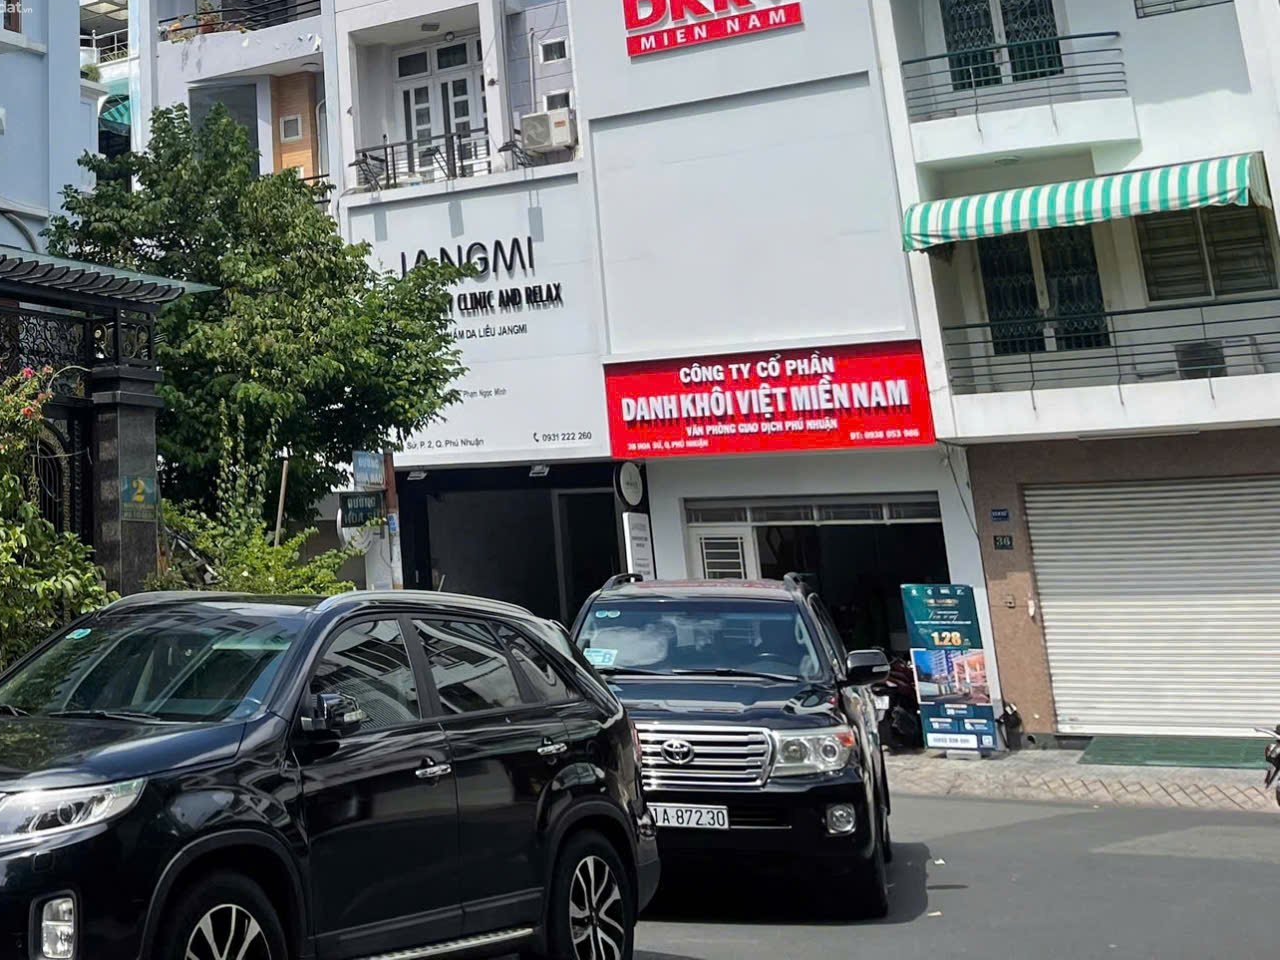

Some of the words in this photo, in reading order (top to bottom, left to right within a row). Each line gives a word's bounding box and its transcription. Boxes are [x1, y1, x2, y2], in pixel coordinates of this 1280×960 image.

[640, 25, 707, 51] MIEN
[726, 9, 786, 33] NAM
[457, 290, 494, 310] CLINIC
[499, 287, 522, 307] AND
[525, 283, 562, 304] RELAX
[466, 329, 477, 339] DA
[498, 324, 527, 336] JANGMI
[679, 362, 725, 383] CÔNG
[729, 362, 751, 380] TY
[756, 353, 781, 377] CỔ
[786, 350, 835, 375] PHẦN
[621, 394, 678, 422] DANH
[681, 386, 733, 419] KHÔI
[735, 383, 788, 418] VIỆT
[790, 374, 851, 412] MIỀN
[852, 378, 910, 408] NAM
[542, 434, 559, 442] 0931
[561, 433, 576, 441] 222
[578, 431, 592, 440] 260
[706, 421, 736, 435] PHÒNG
[738, 422, 759, 434] GIAO
[760, 420, 783, 434] DỊCH
[785, 417, 805, 431] PHÚ
[806, 416, 838, 431] NHUẬN
[131, 479, 145, 503] 2
[653, 807, 726, 827] 1A-872.30
